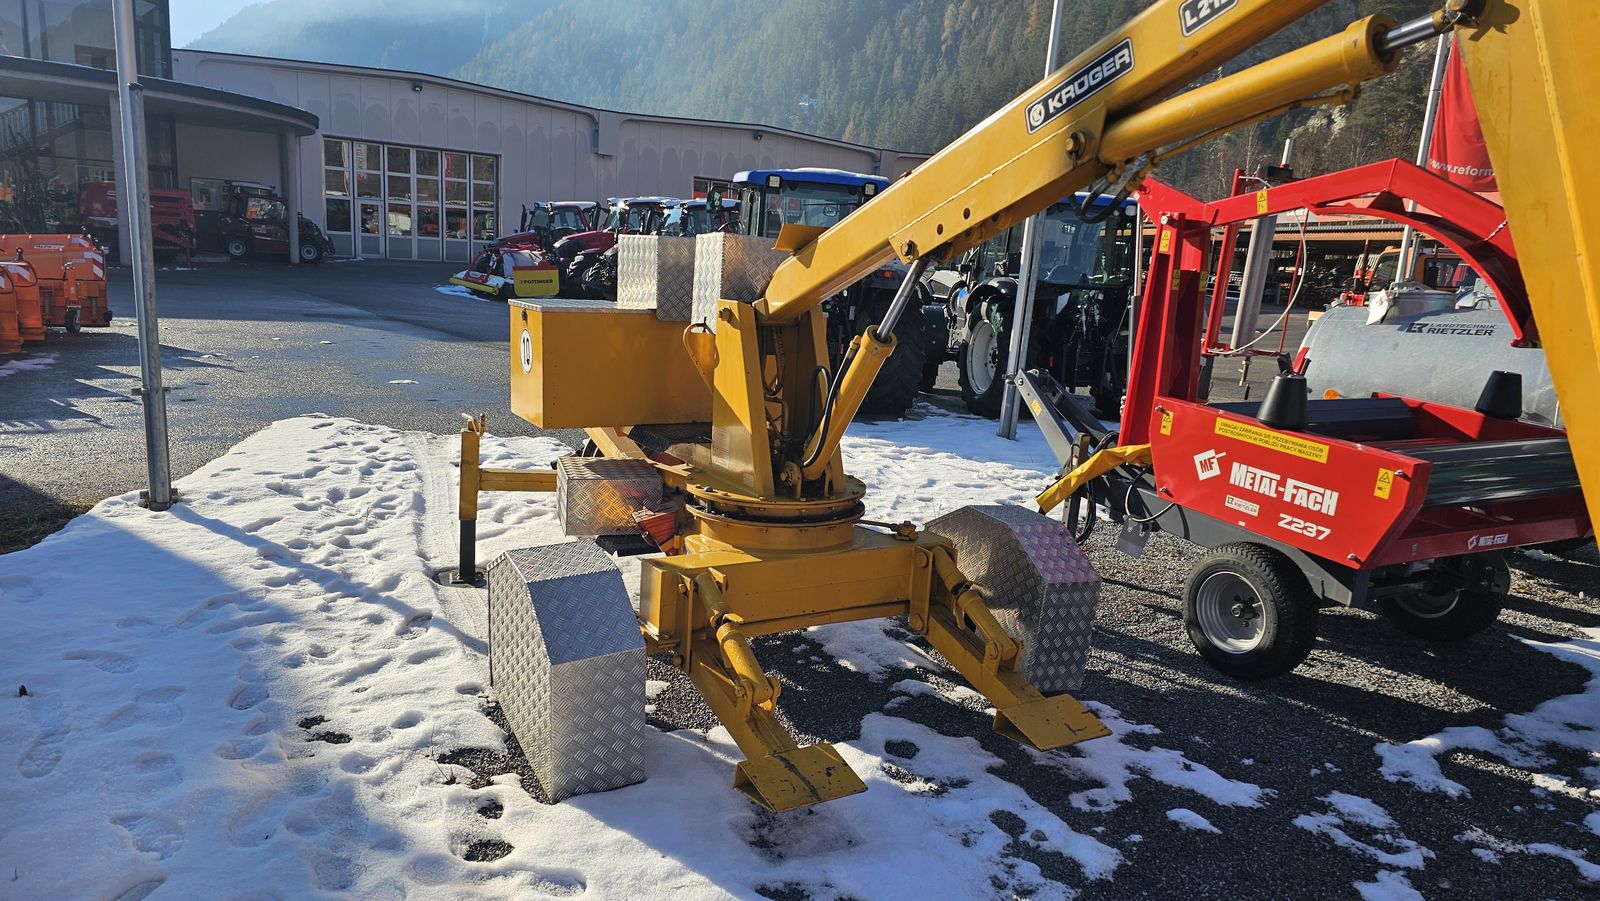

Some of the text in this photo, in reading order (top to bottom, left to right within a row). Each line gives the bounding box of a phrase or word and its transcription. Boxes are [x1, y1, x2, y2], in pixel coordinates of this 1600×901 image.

[1184, 0, 1230, 28] L21
[1048, 48, 1131, 114] KRÜGER
[1426, 327, 1494, 336] RIETZLER
[1239, 426, 1263, 437] ZABRANIA
[1280, 443, 1297, 453] PRACY
[1298, 448, 1323, 459] MASZYNY
[1277, 513, 1332, 541] Z237
